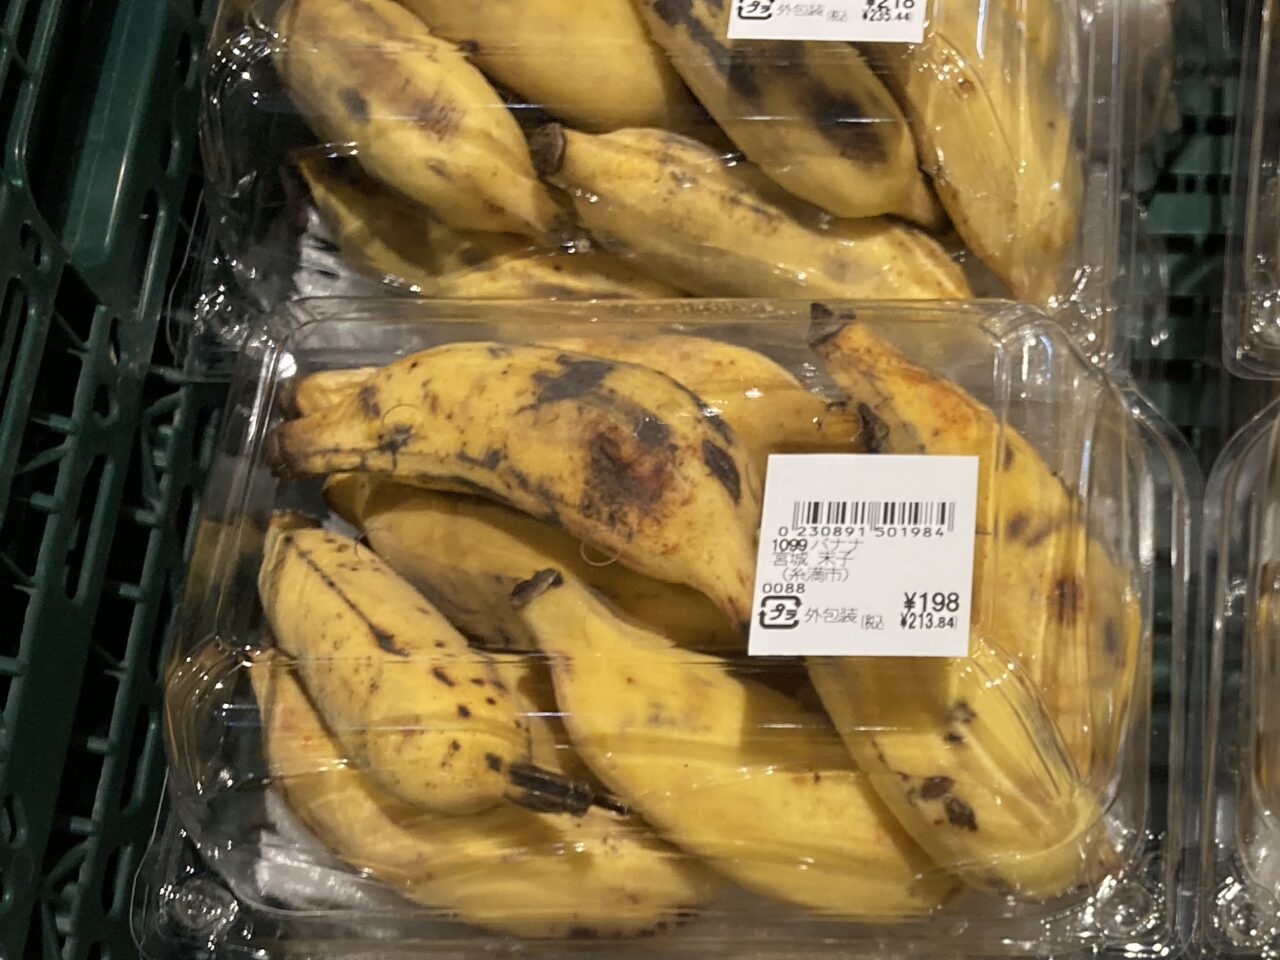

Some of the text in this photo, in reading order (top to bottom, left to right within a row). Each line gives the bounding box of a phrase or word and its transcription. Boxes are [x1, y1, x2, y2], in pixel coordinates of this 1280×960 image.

[779, 527, 944, 537] 0 230891 501984
[773, 539, 864, 551] 1099 バナナ
[773, 552, 808, 566] 宮城
[763, 584, 805, 593] 0088
[904, 593, 959, 612] ¥198
[804, 608, 858, 624] 外包装
